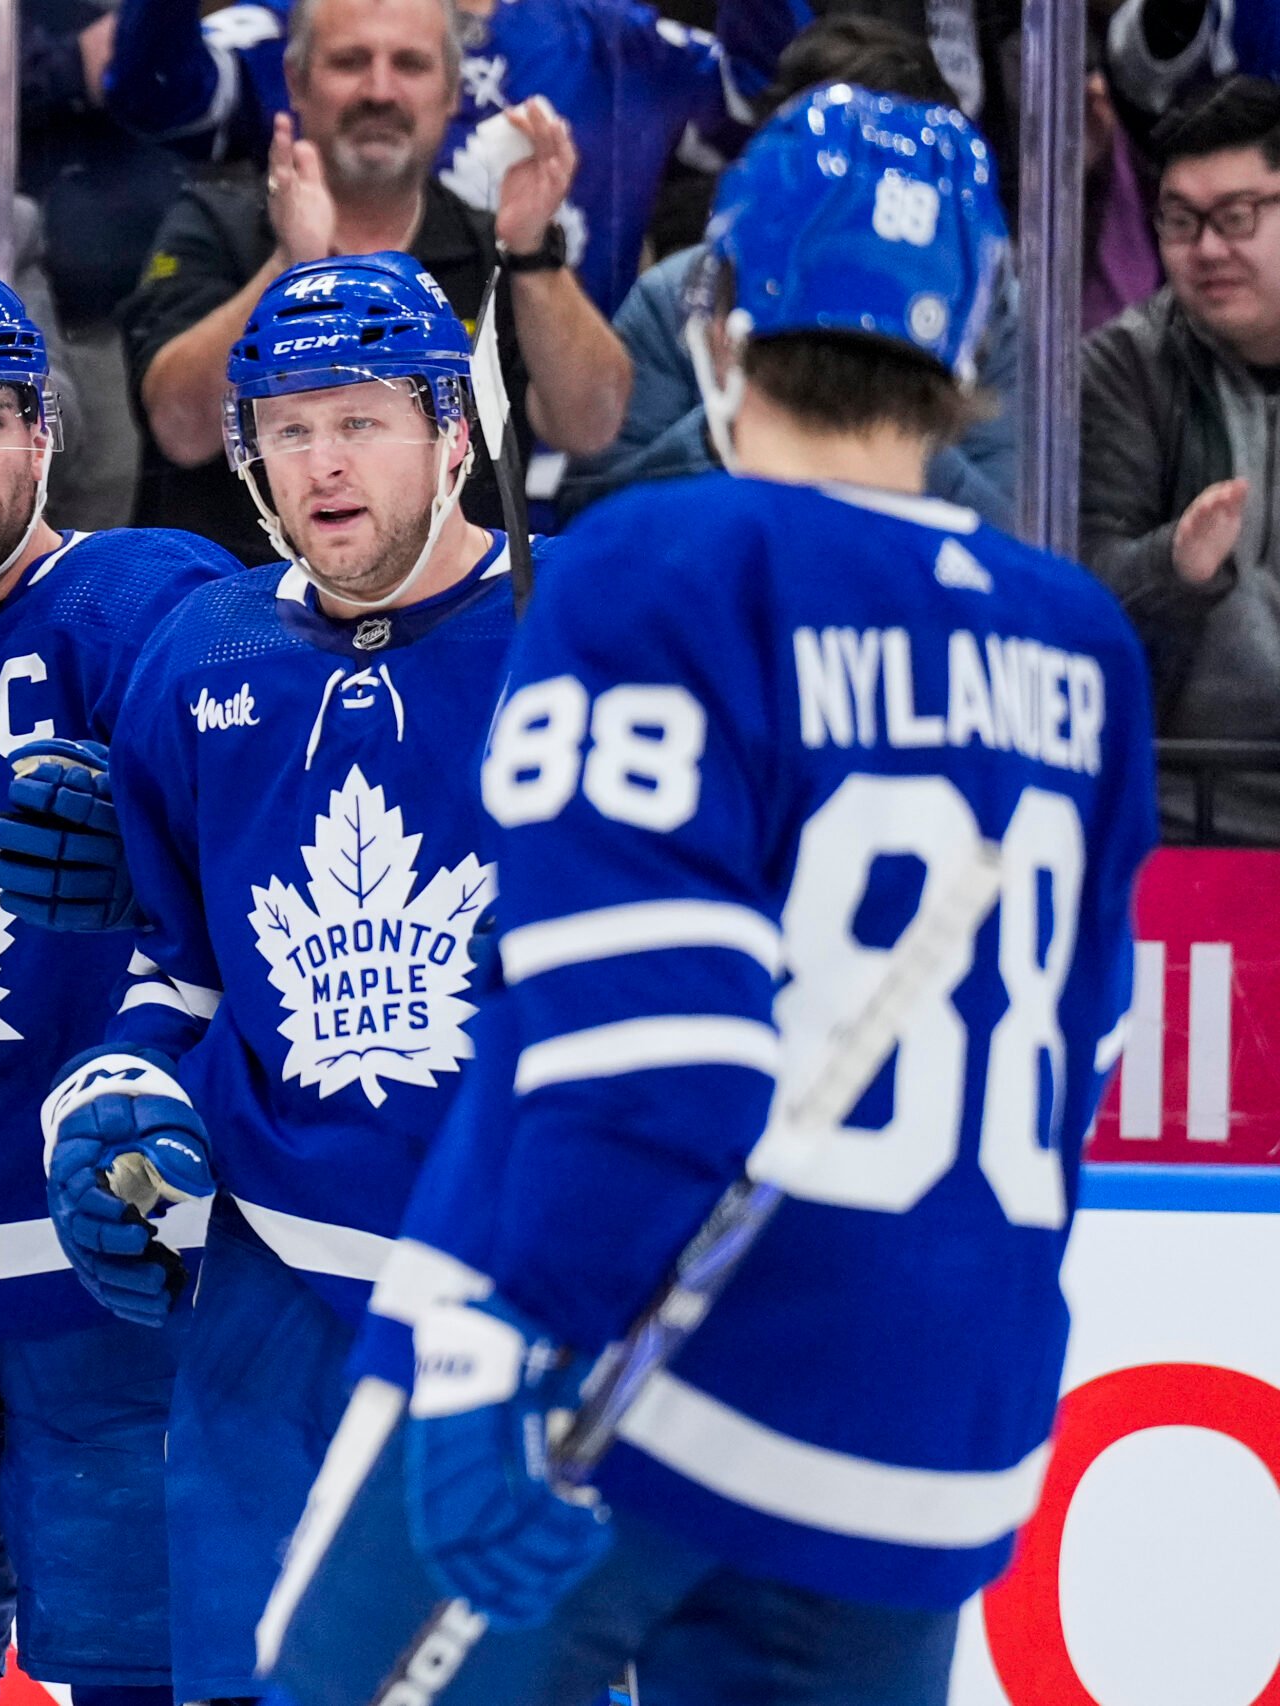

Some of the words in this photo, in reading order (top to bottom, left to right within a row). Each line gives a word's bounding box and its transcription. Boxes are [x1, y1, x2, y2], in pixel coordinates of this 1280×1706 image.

[873, 179, 940, 247] 88
[284, 275, 338, 299] 44
[273, 335, 340, 355] CCM
[792, 625, 1106, 776] NYLANDER
[481, 674, 707, 833] 88
[286, 918, 456, 979] TORONTO
[312, 964, 426, 1004] MAPLE
[768, 773, 1086, 1230] 88
[314, 1001, 429, 1040] LEAFS
